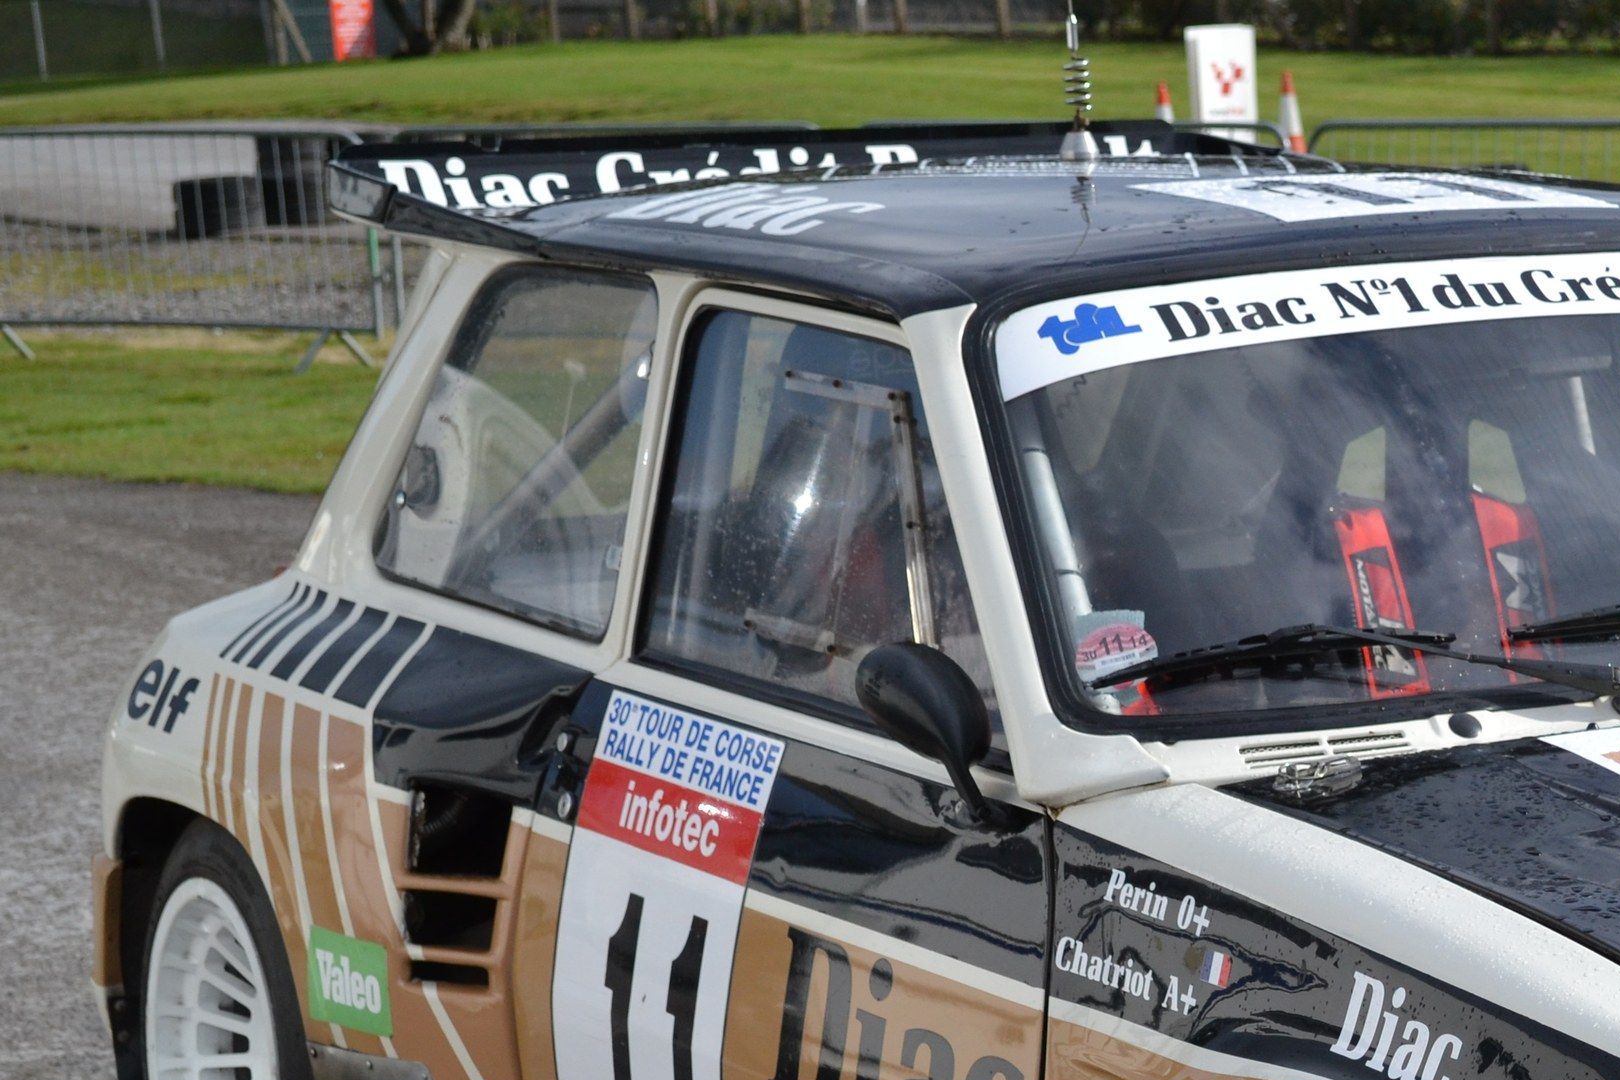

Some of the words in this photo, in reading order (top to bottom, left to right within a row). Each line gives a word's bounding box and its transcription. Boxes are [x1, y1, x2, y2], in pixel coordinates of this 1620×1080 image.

[1150, 296, 1314, 343] Diac
[1432, 274, 1521, 309] du
[127, 658, 199, 733] elf
[603, 729, 660, 768] RALLY
[660, 746, 688, 780] DE
[688, 756, 765, 806] FRANCE
[638, 705, 684, 743] TOUR
[685, 720, 713, 751] DE
[715, 729, 780, 775] CORSE
[618, 780, 720, 857] infotec
[1103, 868, 1169, 924] Perin
[315, 948, 382, 1015] Valeo
[1055, 936, 1153, 1002] Chatriot
[1161, 976, 1198, 1016] A+
